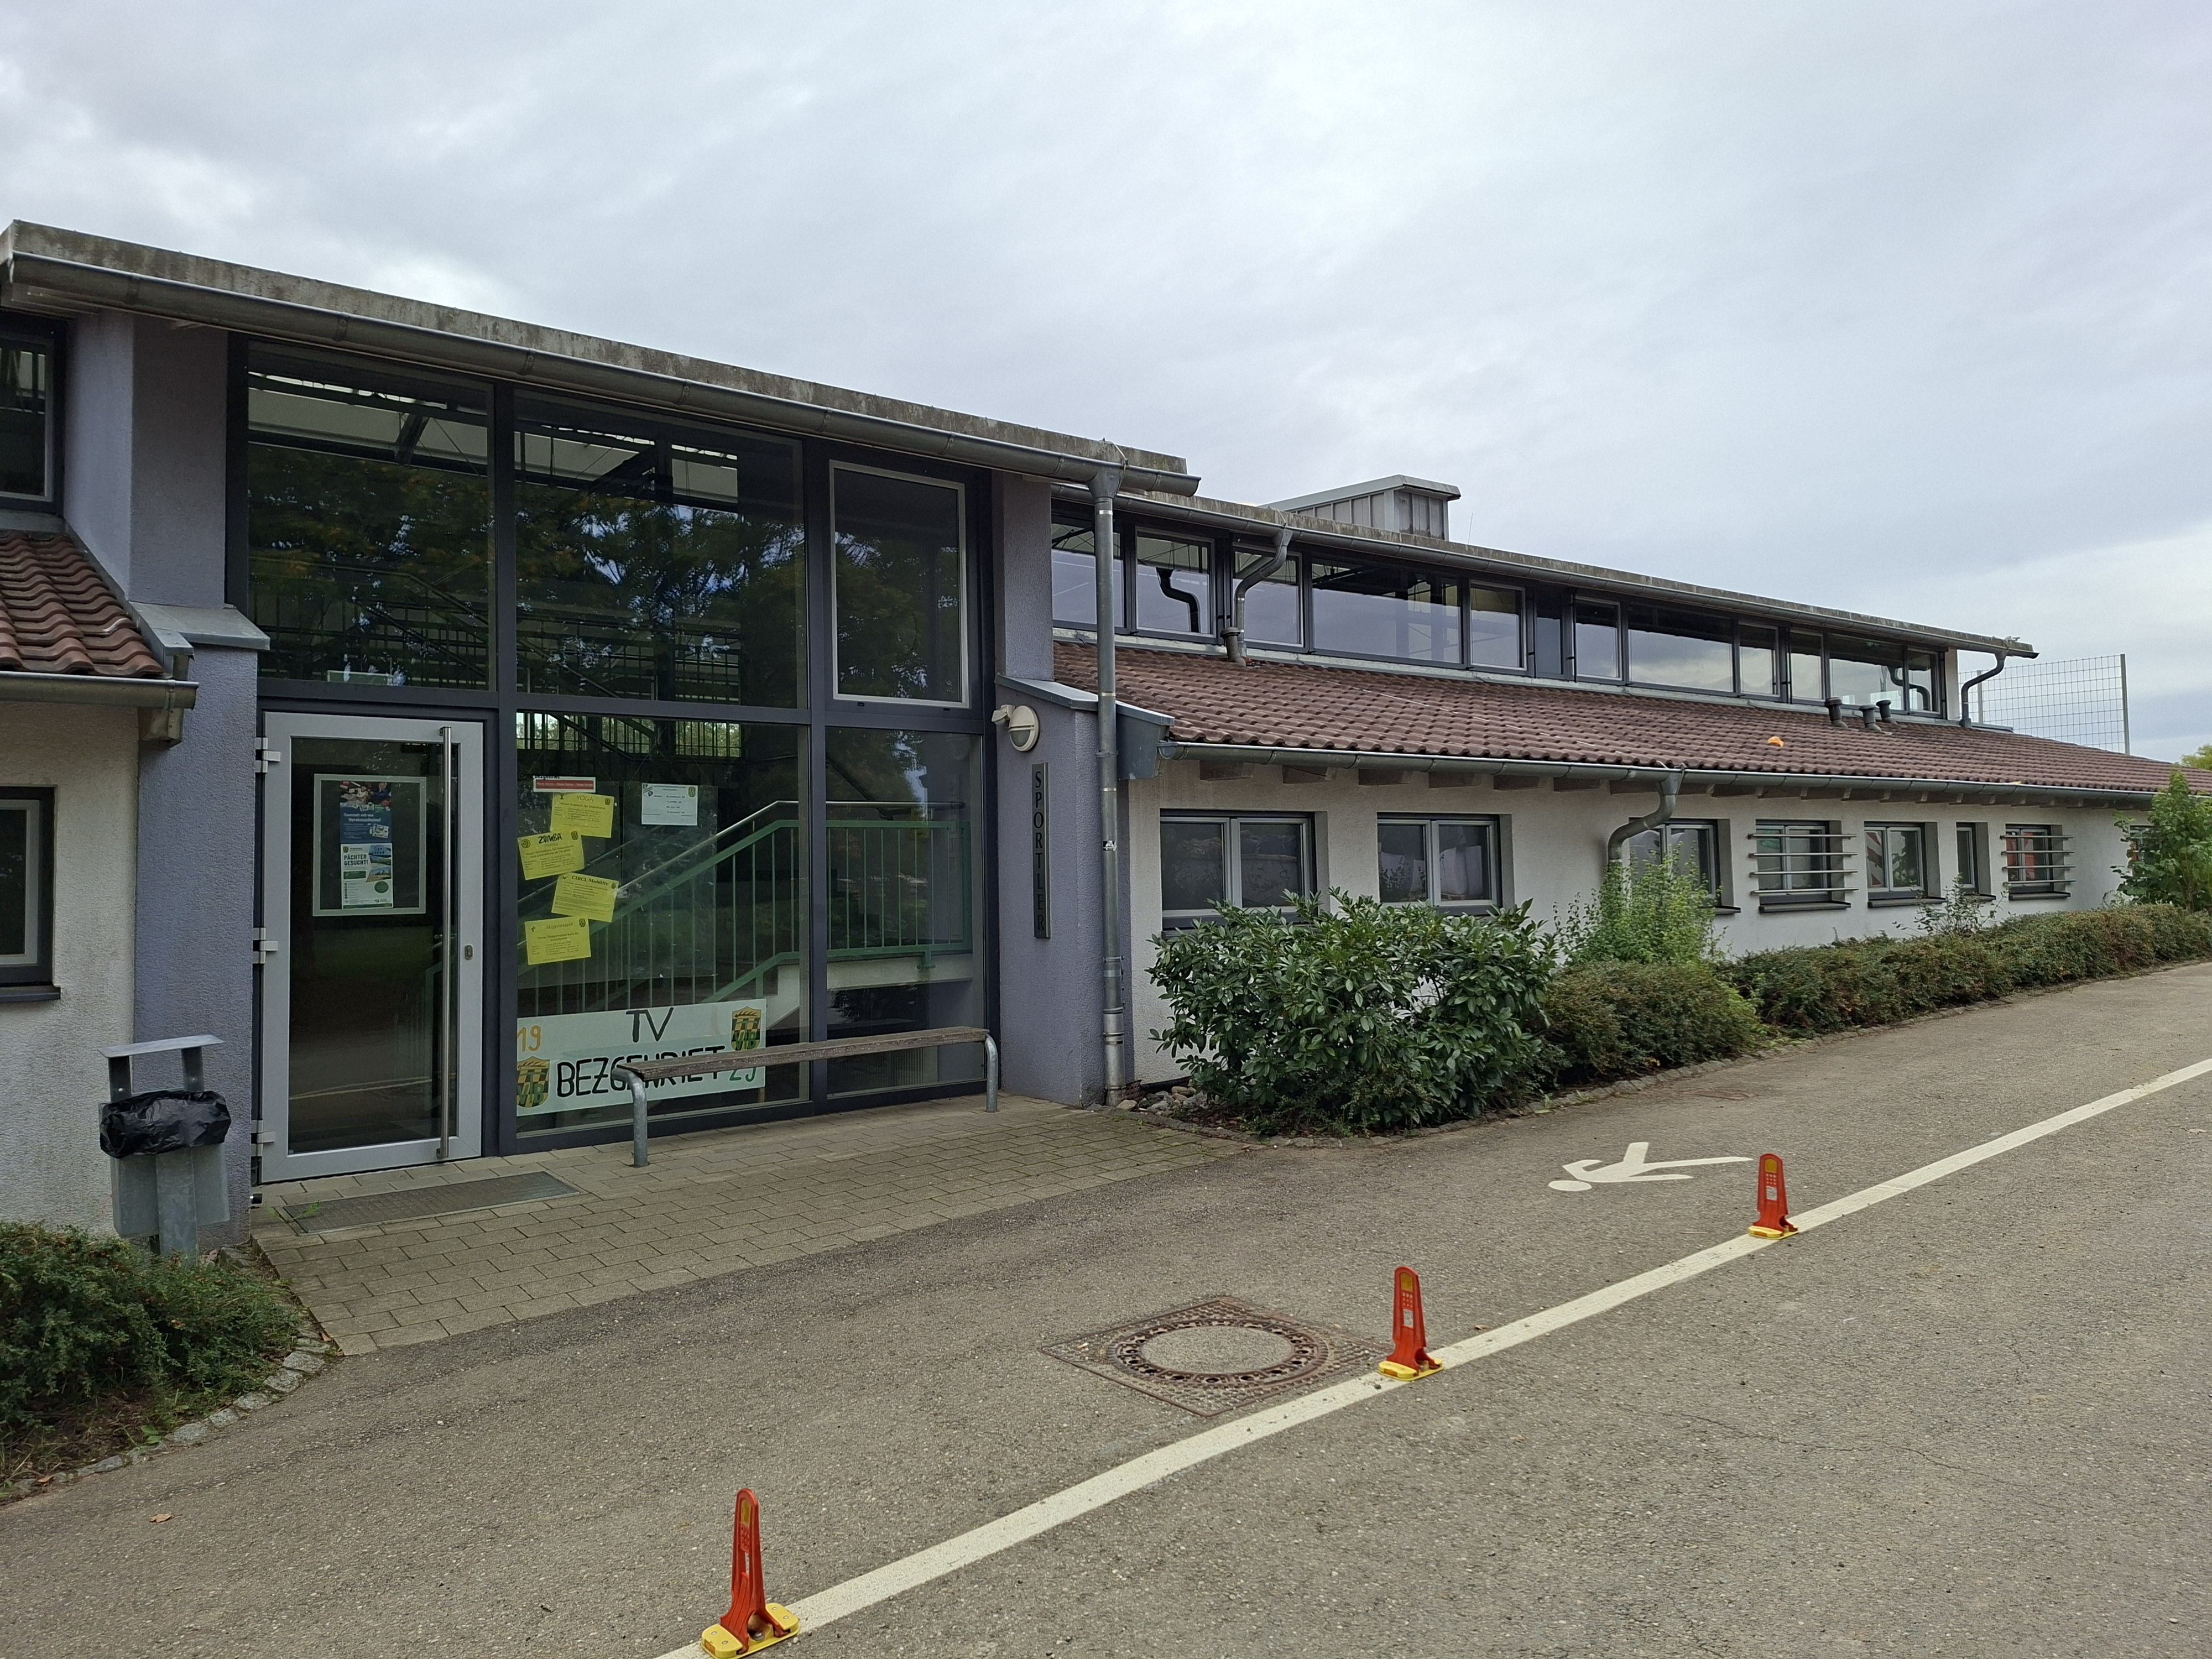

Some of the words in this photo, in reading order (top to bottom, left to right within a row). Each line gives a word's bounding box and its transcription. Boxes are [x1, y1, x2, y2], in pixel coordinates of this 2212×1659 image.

[538, 833, 562, 844] ZUMBA
[1033, 771, 1045, 930] SPORTLER
[517, 1025, 541, 1052] 19
[626, 1007, 674, 1042] TV
